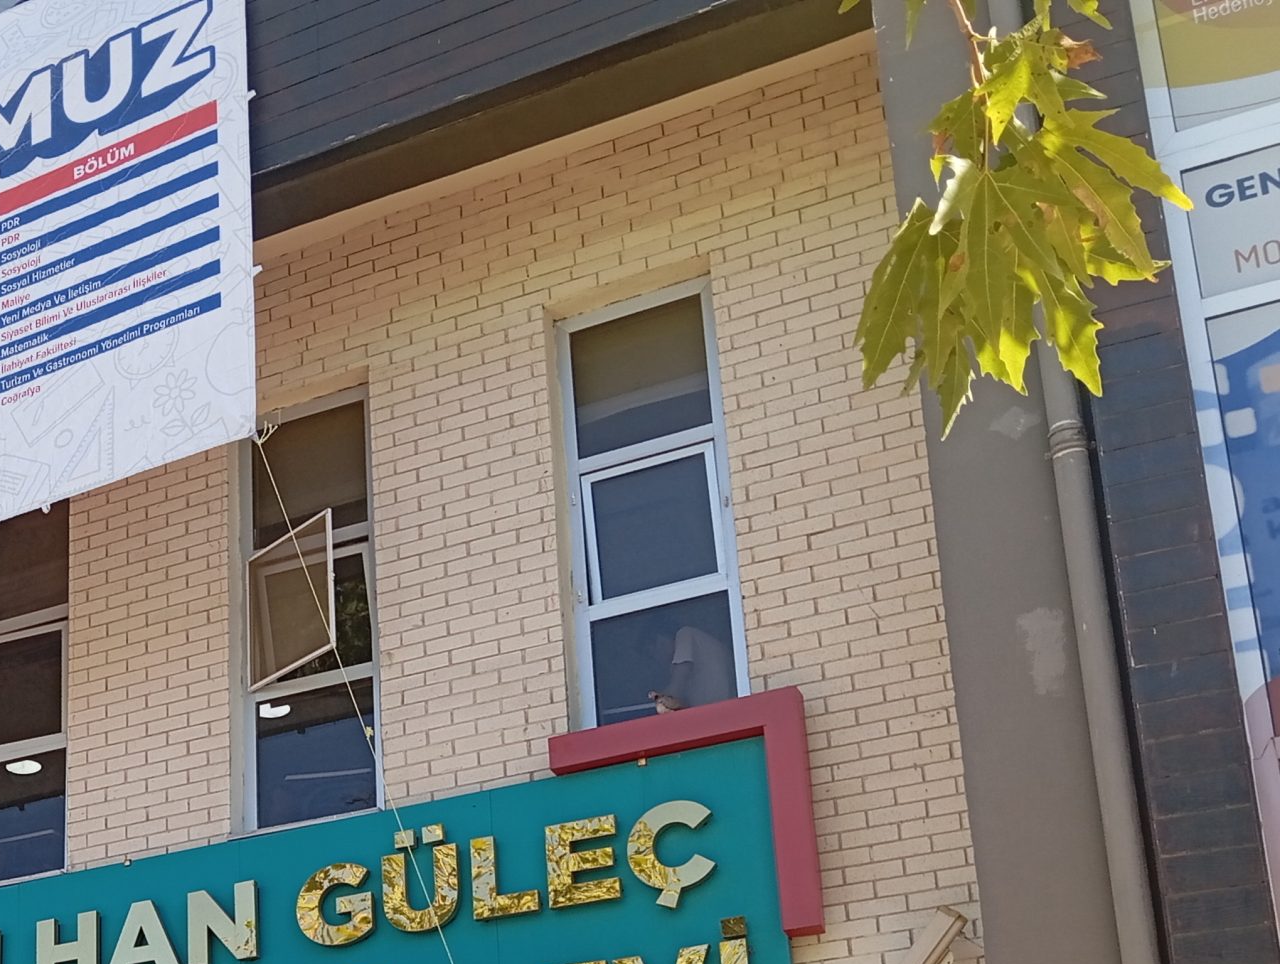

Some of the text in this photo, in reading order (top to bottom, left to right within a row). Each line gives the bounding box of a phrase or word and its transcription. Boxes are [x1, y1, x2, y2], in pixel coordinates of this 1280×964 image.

[73, 142, 135, 180] BÖLÜM
[1, 216, 20, 232] PDR
[1, 233, 20, 247] PDR
[1, 240, 42, 262] Sosyoloji
[1, 256, 42, 278] Sosyoloji
[1, 258, 76, 294] Sosyal Hizmetler
[1, 292, 30, 310] Maliye
[1, 314, 20, 326] Yeni
[22, 300, 52, 318] Medya
[68, 280, 102, 300] İletişim
[1, 324, 32, 342] Siyaset
[36, 311, 60, 328] Bilimi
[76, 286, 131, 312] Uluslararası
[133, 269, 168, 290] İlişkiler
[0, 334, 50, 358] Matematik
[1, 372, 30, 390] Turizm
[46, 345, 99, 372] Gastronomi
[100, 329, 141, 351] Yönetimi
[143, 306, 201, 335] Programları
[1, 337, 77, 374] İlahiyat Fakültesi
[1, 384, 41, 406] Coğrafya
[296, 800, 718, 947] GÜLEÇ
